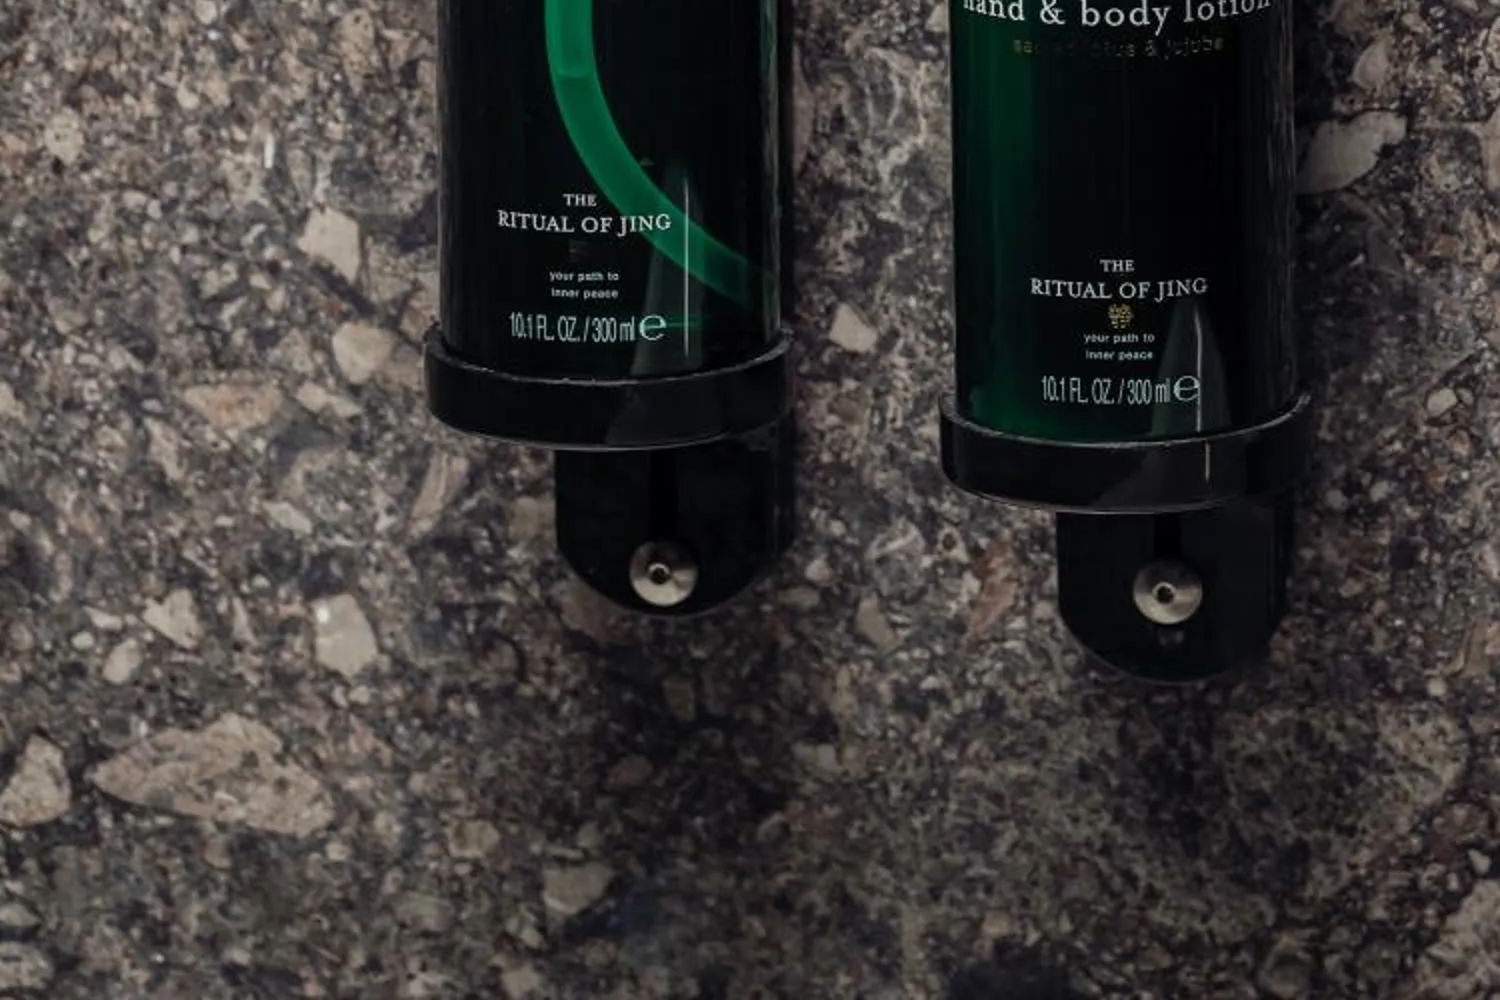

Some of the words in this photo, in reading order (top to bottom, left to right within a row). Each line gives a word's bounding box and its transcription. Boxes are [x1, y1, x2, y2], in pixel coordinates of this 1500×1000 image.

[563, 193, 597, 207] THE
[497, 210, 575, 233] RITUAL
[581, 217, 613, 233] OF
[617, 213, 672, 237] JING
[1100, 259, 1135, 273] THE
[550, 272, 574, 282] your
[577, 271, 604, 283] path
[607, 271, 619, 281] to
[1031, 277, 1113, 299] RITUAL
[1119, 282, 1151, 299] OF
[1154, 277, 1208, 303] JING
[509, 312, 533, 339] 10.1
[583, 316, 591, 342] /
[591, 317, 617, 343] 300
[619, 316, 635, 342] ml
[1084, 334, 1109, 344] your
[1113, 333, 1139, 344] path
[1143, 333, 1155, 343] to
[1041, 375, 1066, 402] 10.1
[1117, 379, 1125, 404] /
[1127, 379, 1151, 404] 300
[1155, 377, 1171, 403] ml
